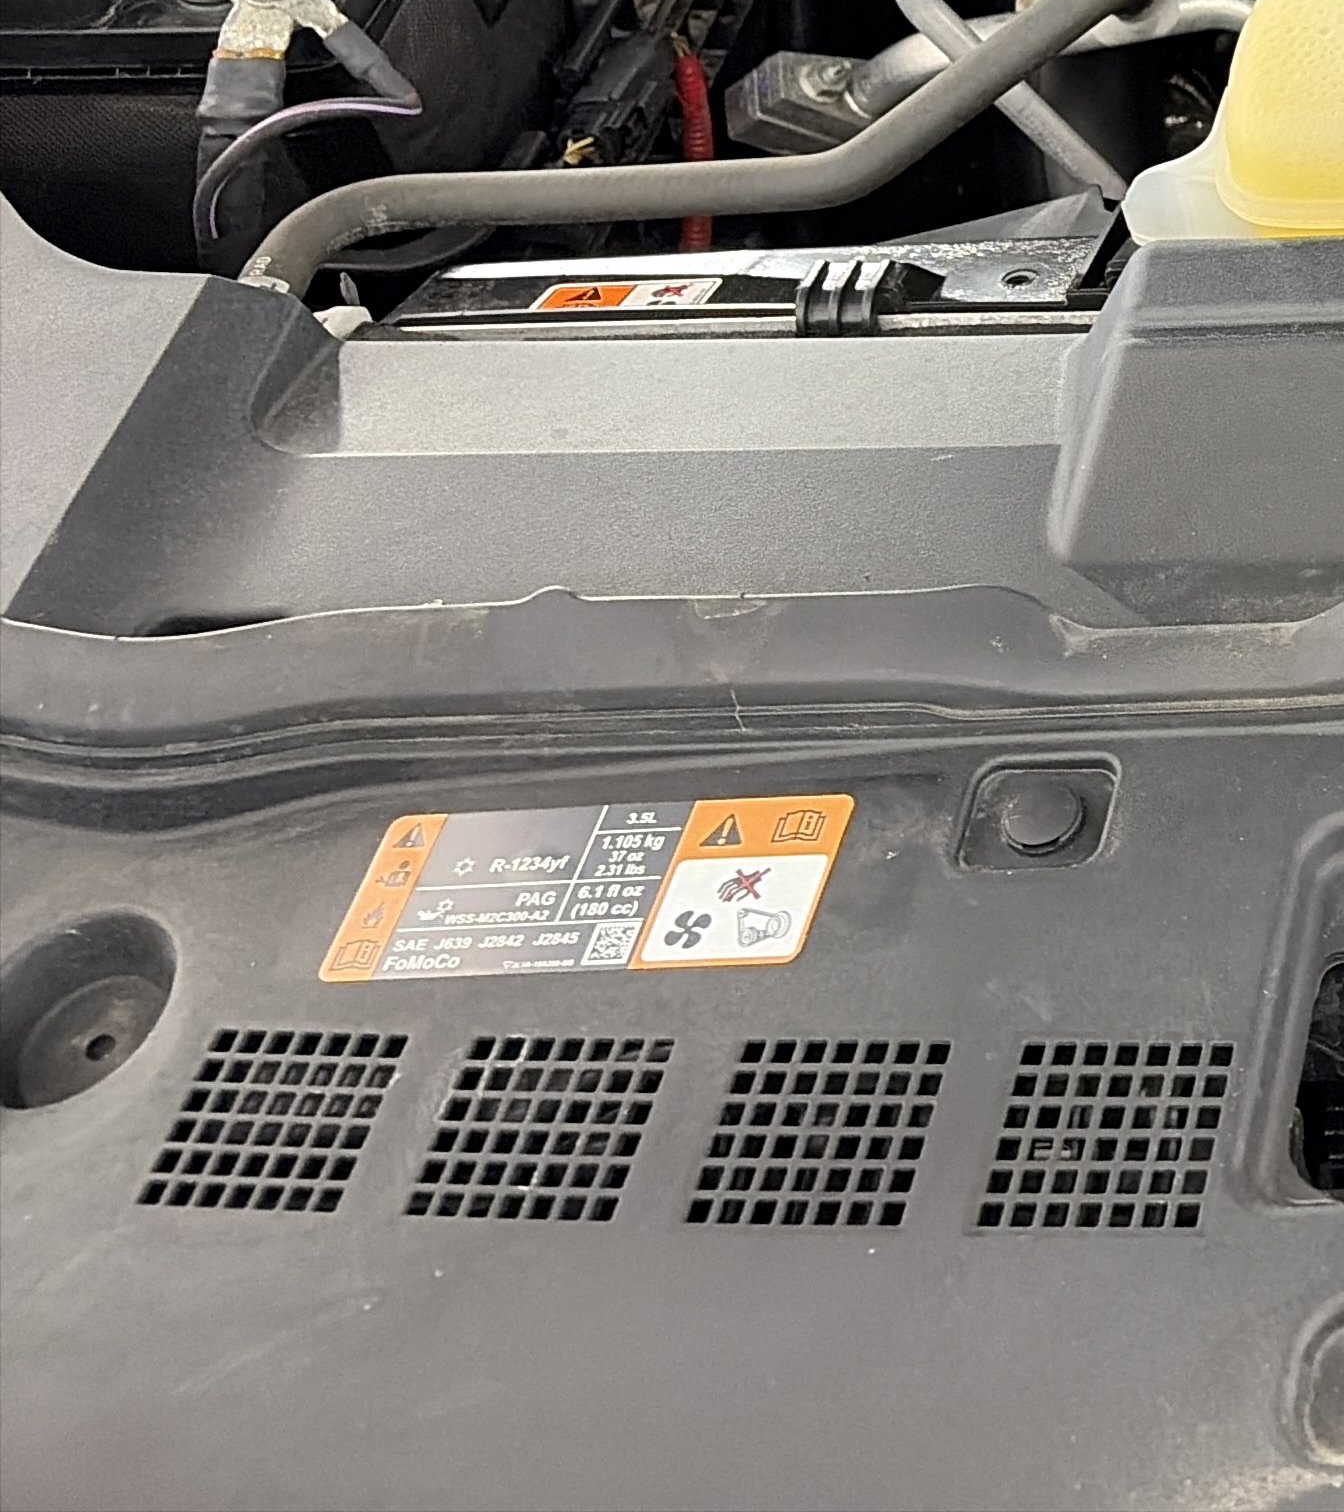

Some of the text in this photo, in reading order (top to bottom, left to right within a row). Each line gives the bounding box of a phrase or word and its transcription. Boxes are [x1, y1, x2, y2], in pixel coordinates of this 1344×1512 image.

[626, 812, 657, 825] 3.5L
[602, 835, 666, 851] 1.105 kg
[489, 854, 571, 873] R-1234yf
[609, 852, 645, 862] 37 oz
[594, 864, 646, 876] 2.31 lbs
[515, 891, 557, 906] PAG
[577, 885, 645, 899] 6.1 fl oz
[571, 901, 639, 919] (180 cc)
[392, 932, 581, 952] SAE J639 J2842 J2845
[382, 956, 461, 971] FoMoCo
